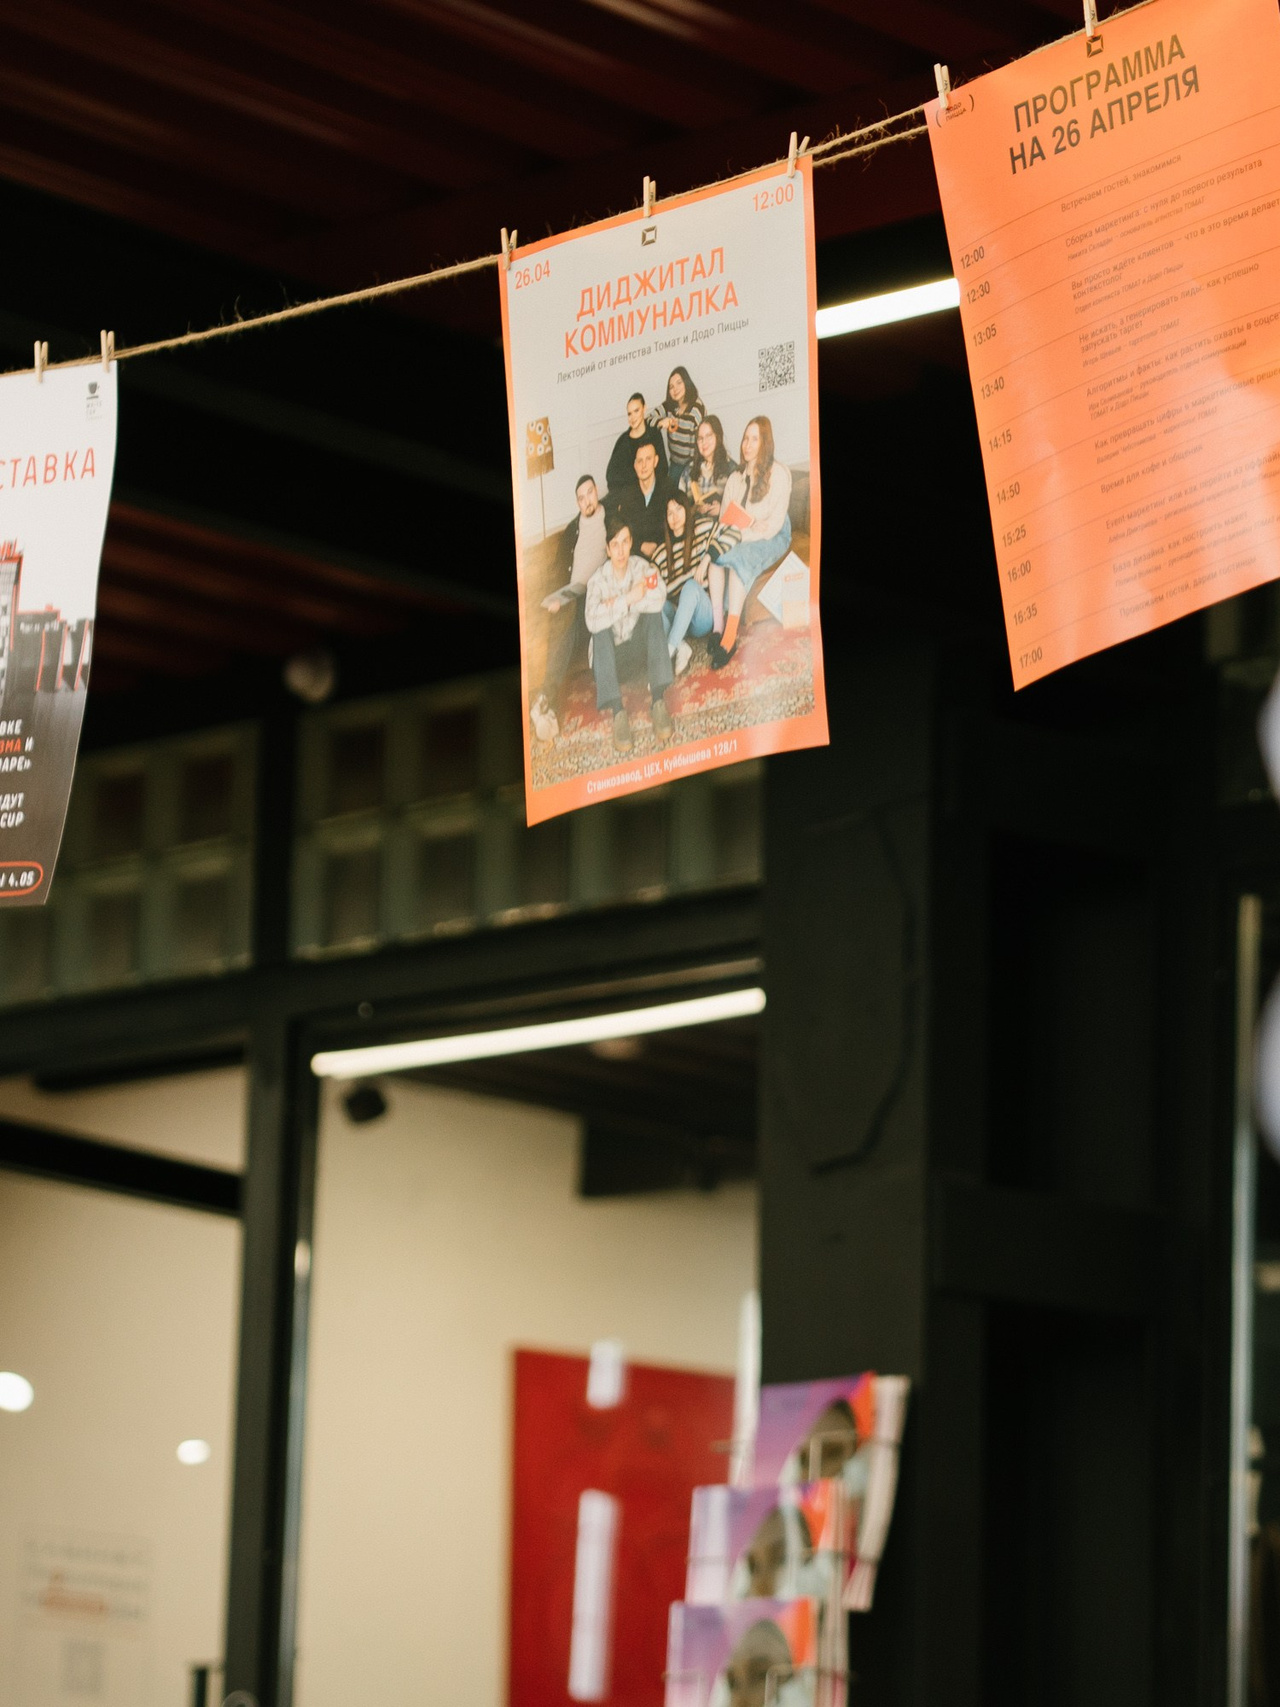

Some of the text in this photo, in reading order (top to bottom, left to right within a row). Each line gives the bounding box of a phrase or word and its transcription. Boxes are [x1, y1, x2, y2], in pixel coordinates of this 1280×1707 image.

[1013, 33, 1186, 133] ПРОГРАММА
[1009, 65, 1200, 175] НА 26 АПРЕЛЯ
[1060, 152, 1181, 214] Встречаем гостей, знакомимся
[753, 183, 794, 212] 12:00
[1065, 156, 1262, 249] Сборка маркетинга: с нуля до первого результата
[1184, 194, 1205, 211] ТОМАТ
[1071, 277, 1082, 290] Вы
[1084, 266, 1110, 286] просто
[1137, 239, 1174, 262] клиентов
[1184, 229, 1198, 242] что
[1199, 226, 1205, 235] в
[1207, 220, 1221, 232] это
[1222, 208, 1249, 228] время
[1250, 195, 1280, 217] делает
[960, 245, 985, 269] 12:00
[514, 260, 550, 289] 26.04
[576, 247, 724, 322] ДИДЖИТАЛ
[1072, 272, 1122, 300] контекстолог
[1121, 278, 1141, 293] ТОМАТ
[966, 280, 990, 304] 12:30
[1078, 331, 1089, 344] Не
[1125, 292, 1179, 325] генерировать
[1206, 276, 1221, 289] как
[1222, 260, 1259, 284] успешно
[565, 281, 739, 359] КОММУНАЛКА
[972, 323, 997, 347] 13:05
[1080, 319, 1143, 356] запускать таргет
[557, 361, 596, 384] Лекторий
[609, 346, 652, 369] агентства
[654, 336, 681, 353] Томат
[691, 327, 715, 344] Додо
[717, 317, 750, 335] Пиццы
[1085, 370, 1128, 399] Алгоритмы
[1164, 350, 1177, 362] как
[1179, 335, 1211, 356] растить
[1213, 322, 1244, 344] охваты
[1246, 321, 1251, 330] в
[980, 375, 1005, 399] 13:40
[1094, 436, 1108, 450] Как
[1109, 417, 1154, 445] превращать
[1156, 404, 1182, 424] цифры
[1191, 374, 1254, 410] маркетинговые
[988, 427, 1012, 451] 14:15
[1100, 475, 1124, 495] Время
[1125, 470, 1139, 483] для
[1141, 460, 1160, 476] кофе
[1168, 441, 1203, 465] общения
[996, 481, 1021, 504] 14:50
[1002, 523, 1027, 547] 15:25
[1006, 559, 1032, 583] 16:00
[1012, 602, 1038, 626] 16:35
[1018, 645, 1043, 669] 17:00
[25, 737, 34, 752] И
[0, 755, 31, 772] АРЕ»
[587, 739, 738, 794] Станкозавод, ЦЕХ, Куйбышева 128/1
[0, 792, 24, 811] ДУТ
